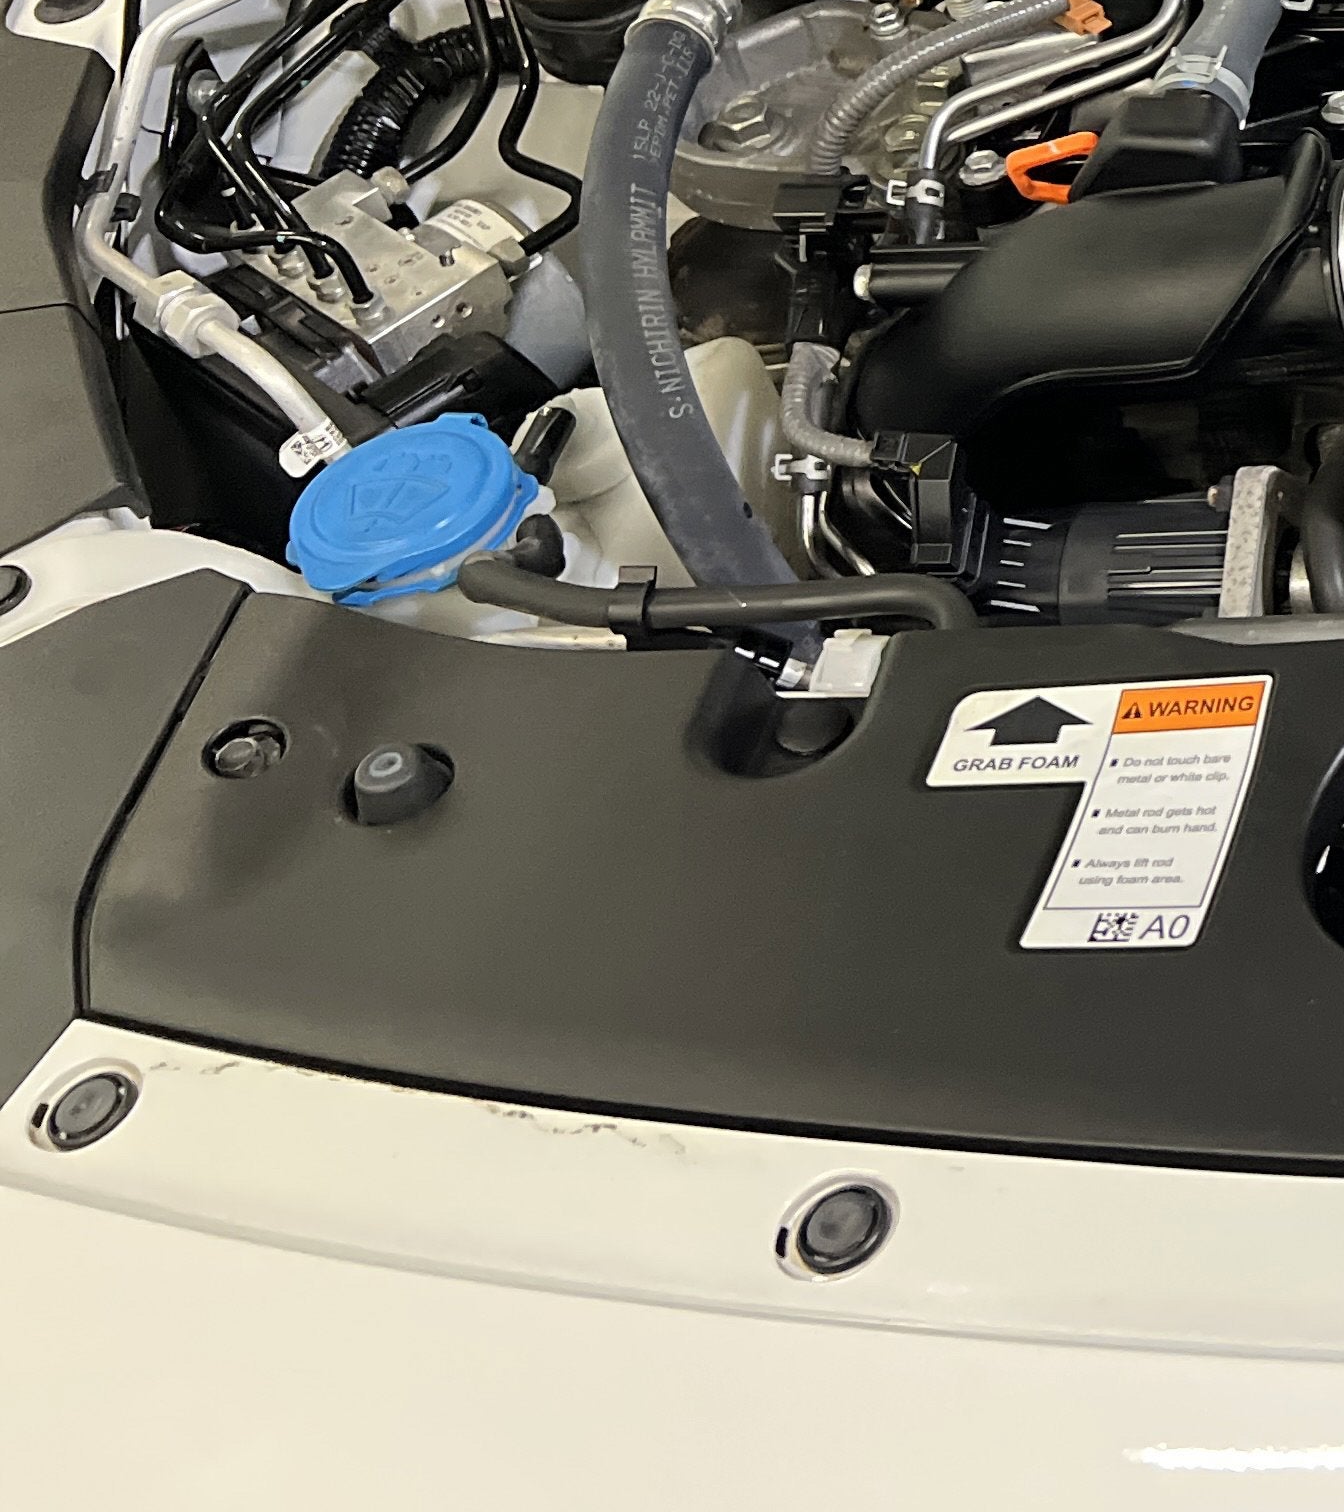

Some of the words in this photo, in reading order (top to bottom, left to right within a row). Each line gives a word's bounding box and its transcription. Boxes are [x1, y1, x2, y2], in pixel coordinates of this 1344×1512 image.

[1148, 696, 1255, 717] WARNING
[953, 757, 1013, 772] GRAB
[1018, 755, 1081, 770] FOAM
[1122, 758, 1141, 768] Do
[1144, 757, 1164, 767] not
[1167, 754, 1200, 766] touch
[1203, 754, 1232, 763] bare
[1117, 774, 1153, 784] metal
[1154, 775, 1167, 783] or
[1170, 772, 1202, 782] white
[1105, 808, 1140, 818] Metal
[1142, 807, 1164, 817] rod
[1165, 808, 1192, 819] gets
[1195, 806, 1217, 816] hot
[1098, 825, 1123, 835] and
[1125, 826, 1148, 834] can
[1151, 823, 1180, 833] burn
[1084, 858, 1130, 870] Always
[1133, 858, 1149, 868] lift
[1151, 857, 1174, 867] rod
[1078, 876, 1114, 887] using
[1116, 875, 1149, 884] foam
